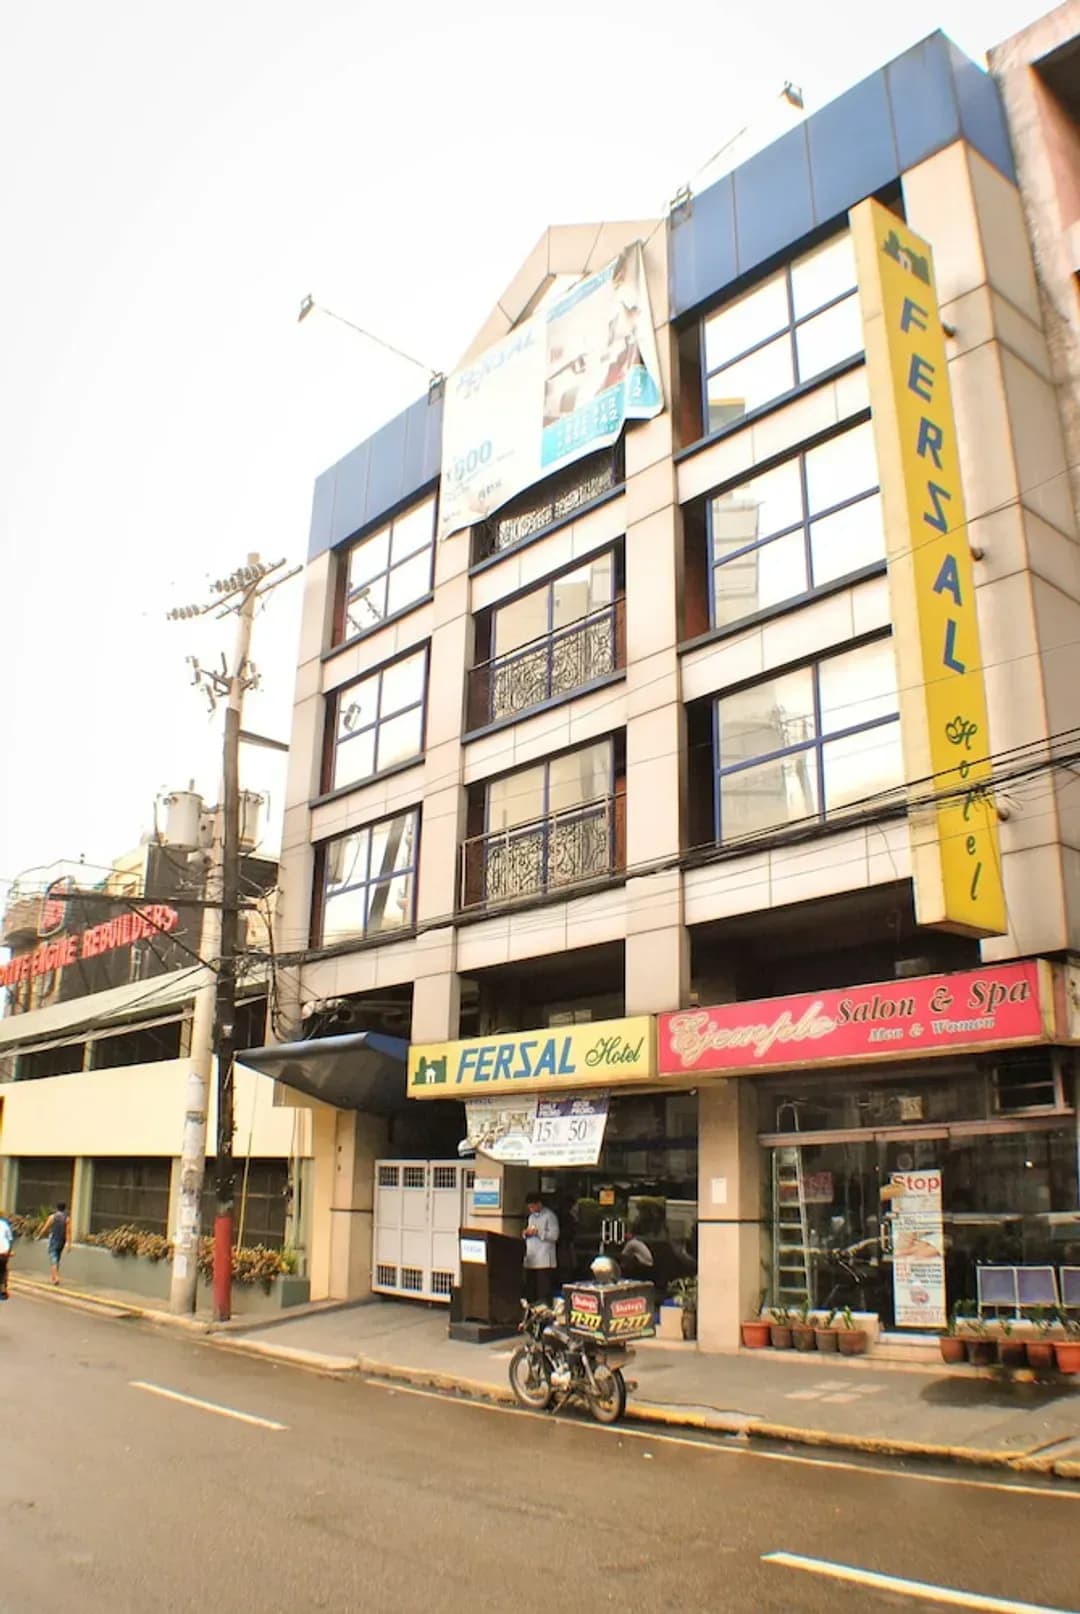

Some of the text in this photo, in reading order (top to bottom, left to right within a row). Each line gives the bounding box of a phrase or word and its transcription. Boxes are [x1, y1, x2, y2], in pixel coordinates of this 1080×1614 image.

[900, 296, 966, 676] FERSAL
[82, 904, 178, 959] REBUILDERS
[836, 994, 916, 1026] Salon
[930, 987, 954, 1013] &
[968, 979, 1031, 1014] Spa
[868, 1015, 996, 1043] Men & Women
[455, 1035, 645, 1084] FERSAL Hotel
